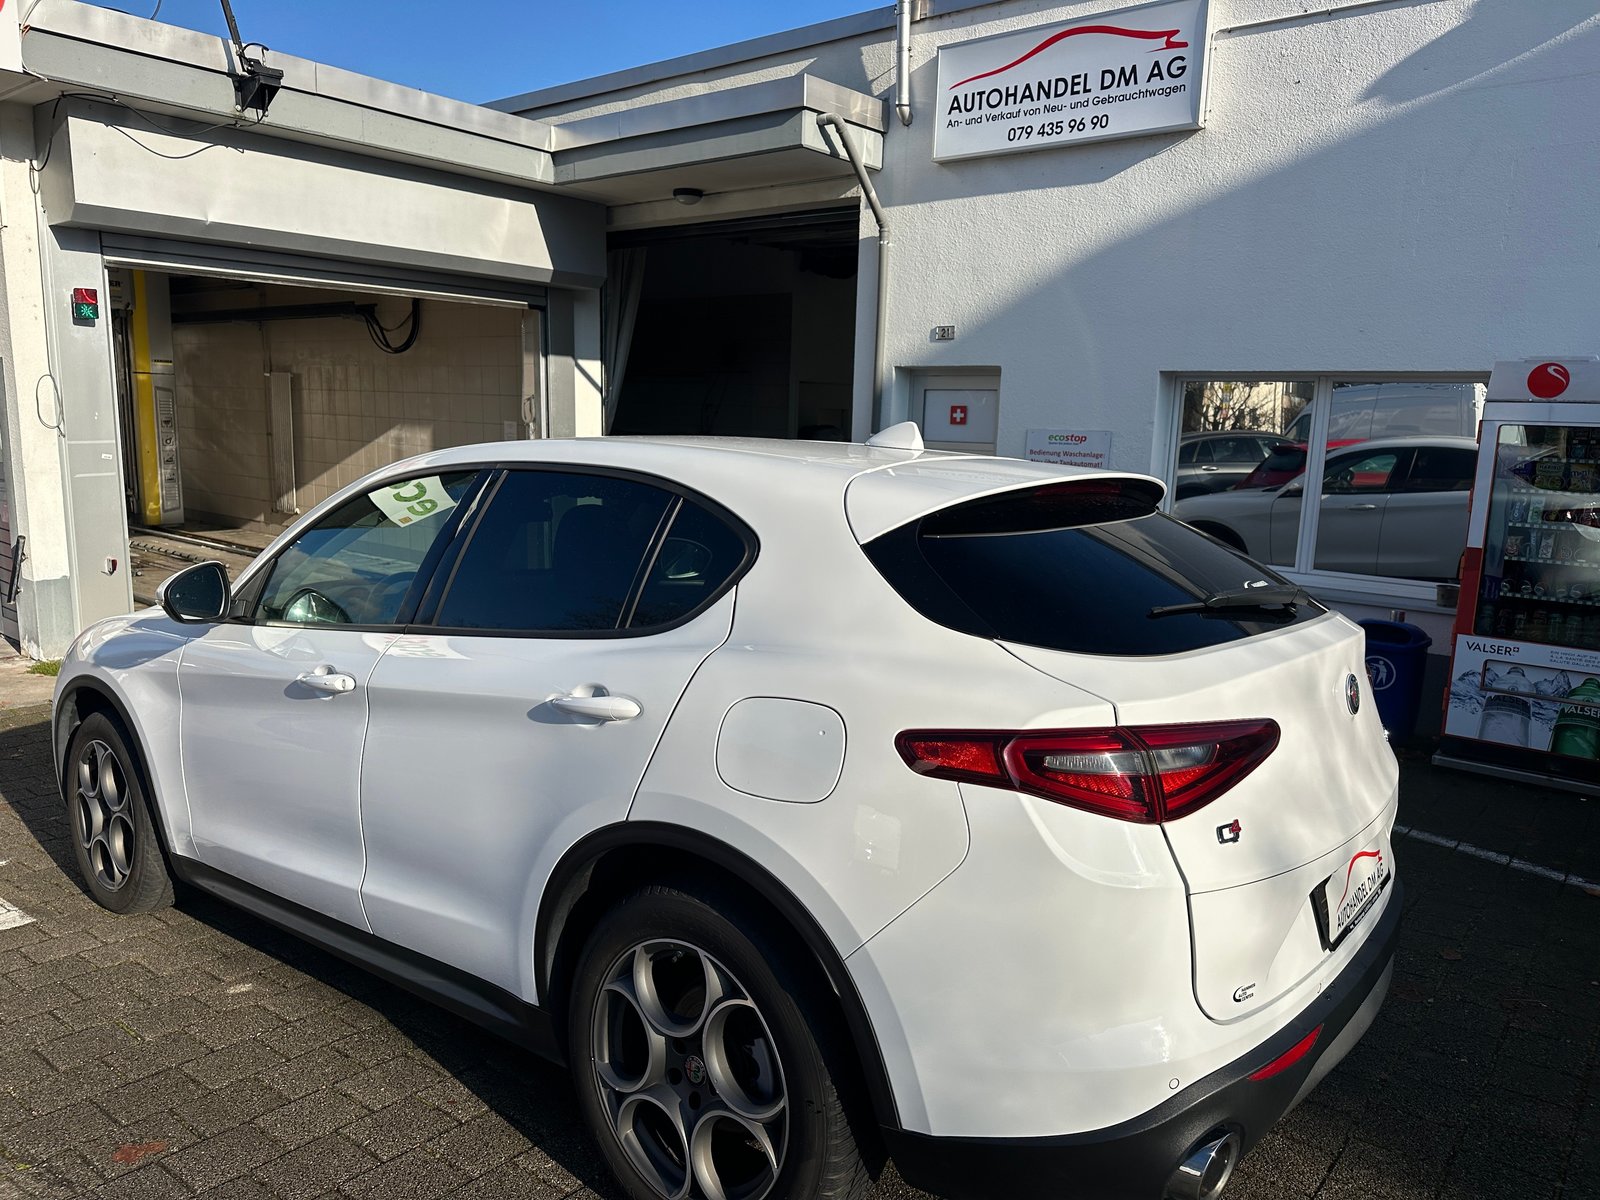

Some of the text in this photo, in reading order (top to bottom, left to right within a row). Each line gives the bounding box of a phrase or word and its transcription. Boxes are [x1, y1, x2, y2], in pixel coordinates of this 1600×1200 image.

[947, 55, 1188, 115] AUTOHANDEL DM AG
[946, 83, 1187, 128] An- und Verkauf von Neu- und Gebrauchtwagen
[1007, 113, 1109, 142] 079 435 96 90
[1048, 433, 1087, 444] ecostop
[1466, 641, 1513, 656] VALSER
[1337, 862, 1384, 931] AUTOHANDEL DM AG
